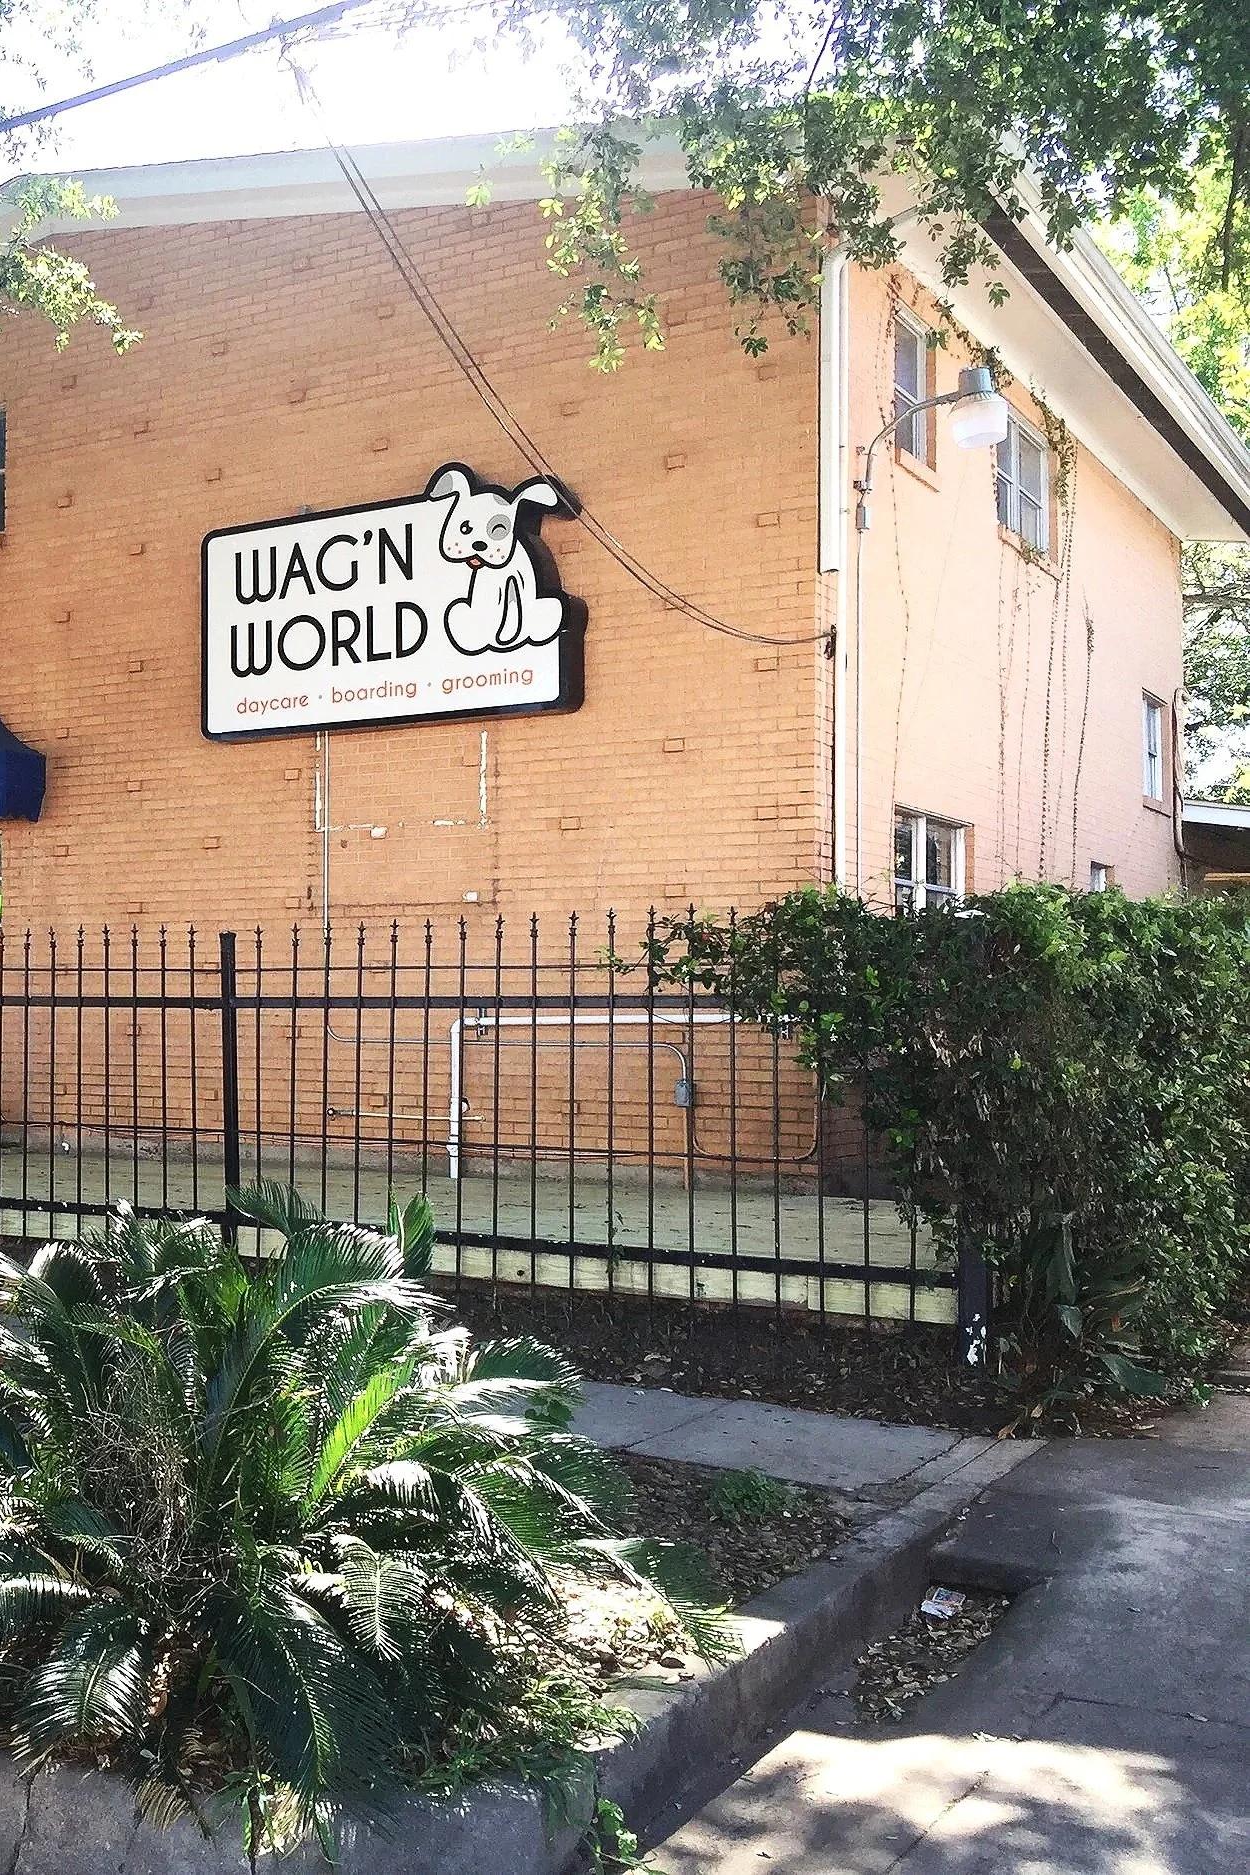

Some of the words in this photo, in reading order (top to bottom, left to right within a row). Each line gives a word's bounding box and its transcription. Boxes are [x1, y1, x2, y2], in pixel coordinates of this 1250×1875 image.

[235, 523, 413, 605] WAG'N
[231, 601, 428, 678] WORLD
[236, 692, 309, 714] daycare
[331, 679, 417, 704] boarding
[441, 667, 534, 694] grooming
